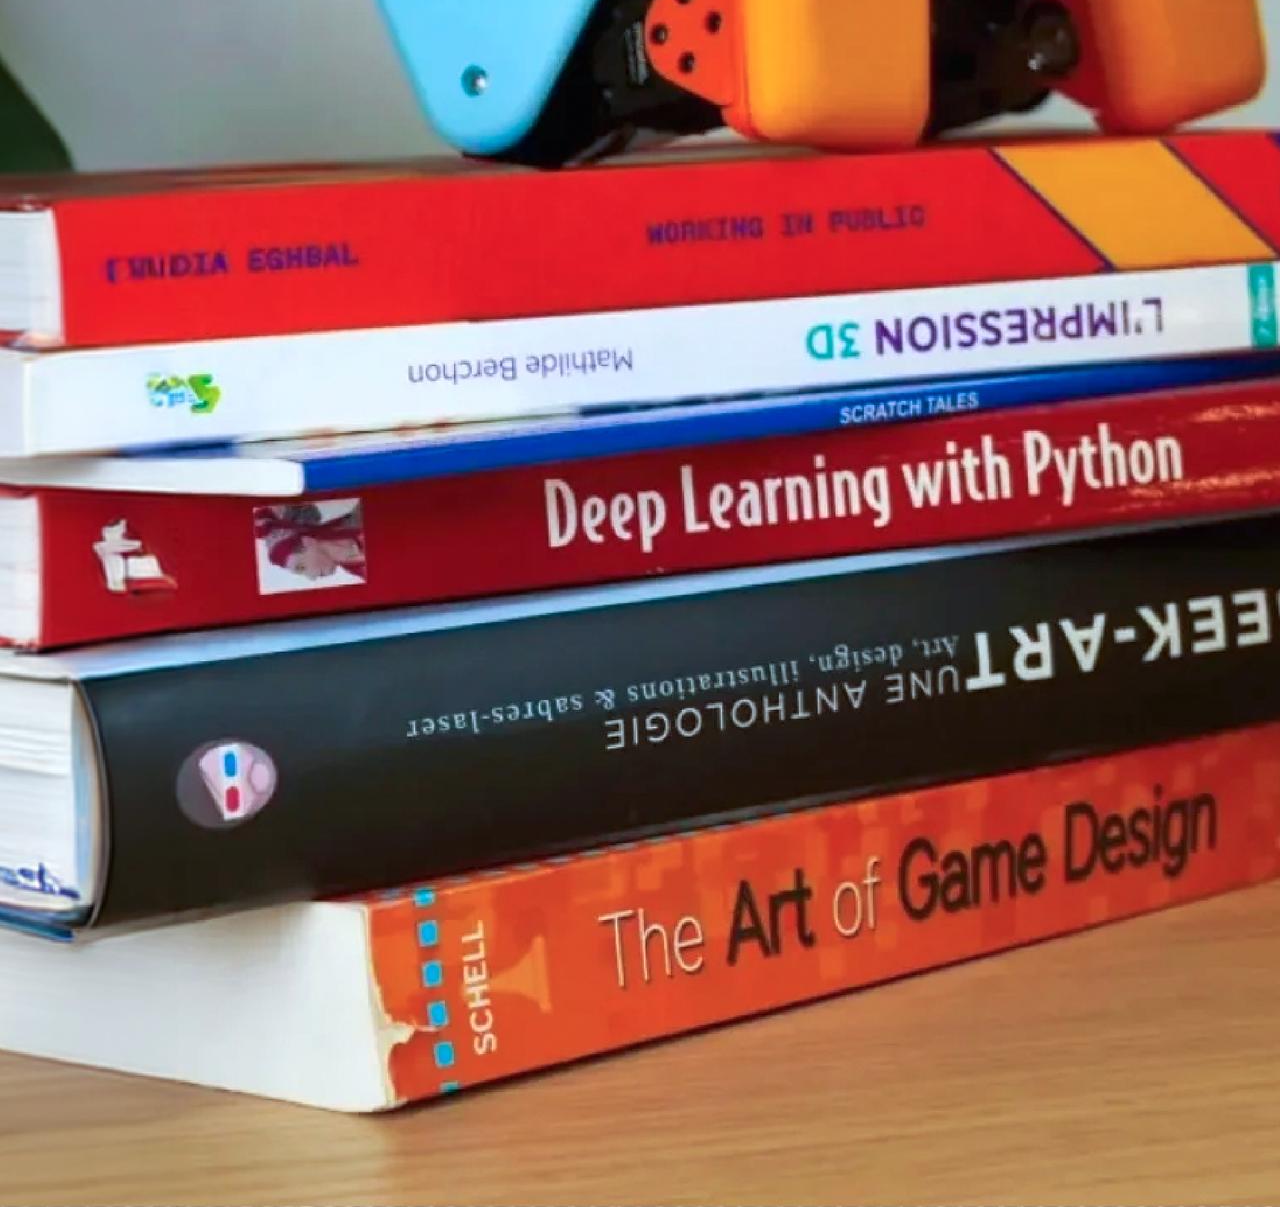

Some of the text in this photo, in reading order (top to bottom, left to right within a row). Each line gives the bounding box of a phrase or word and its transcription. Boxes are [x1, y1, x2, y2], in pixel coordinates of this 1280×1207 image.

[782, 212, 813, 237] IN
[248, 242, 359, 272] EGHBAL
[805, 297, 1163, 360] L'IMPRESSION 3D
[407, 347, 634, 384] Mathilde Berchon
[839, 392, 979, 424] SCRATCH TALES
[544, 422, 1184, 554] Deep Learning with Python
[809, 641, 904, 673] design,
[595, 688, 615, 710] &
[627, 658, 800, 702] illustrations
[406, 692, 584, 739] sabres-laser
[605, 664, 961, 750] UNE ANTHOLOGIE
[598, 907, 704, 988] The
[727, 864, 815, 965] Art
[832, 856, 881, 938] of
[899, 827, 1047, 922] Game
[1063, 782, 1219, 877] Design
[462, 920, 498, 1057] SCHELL
